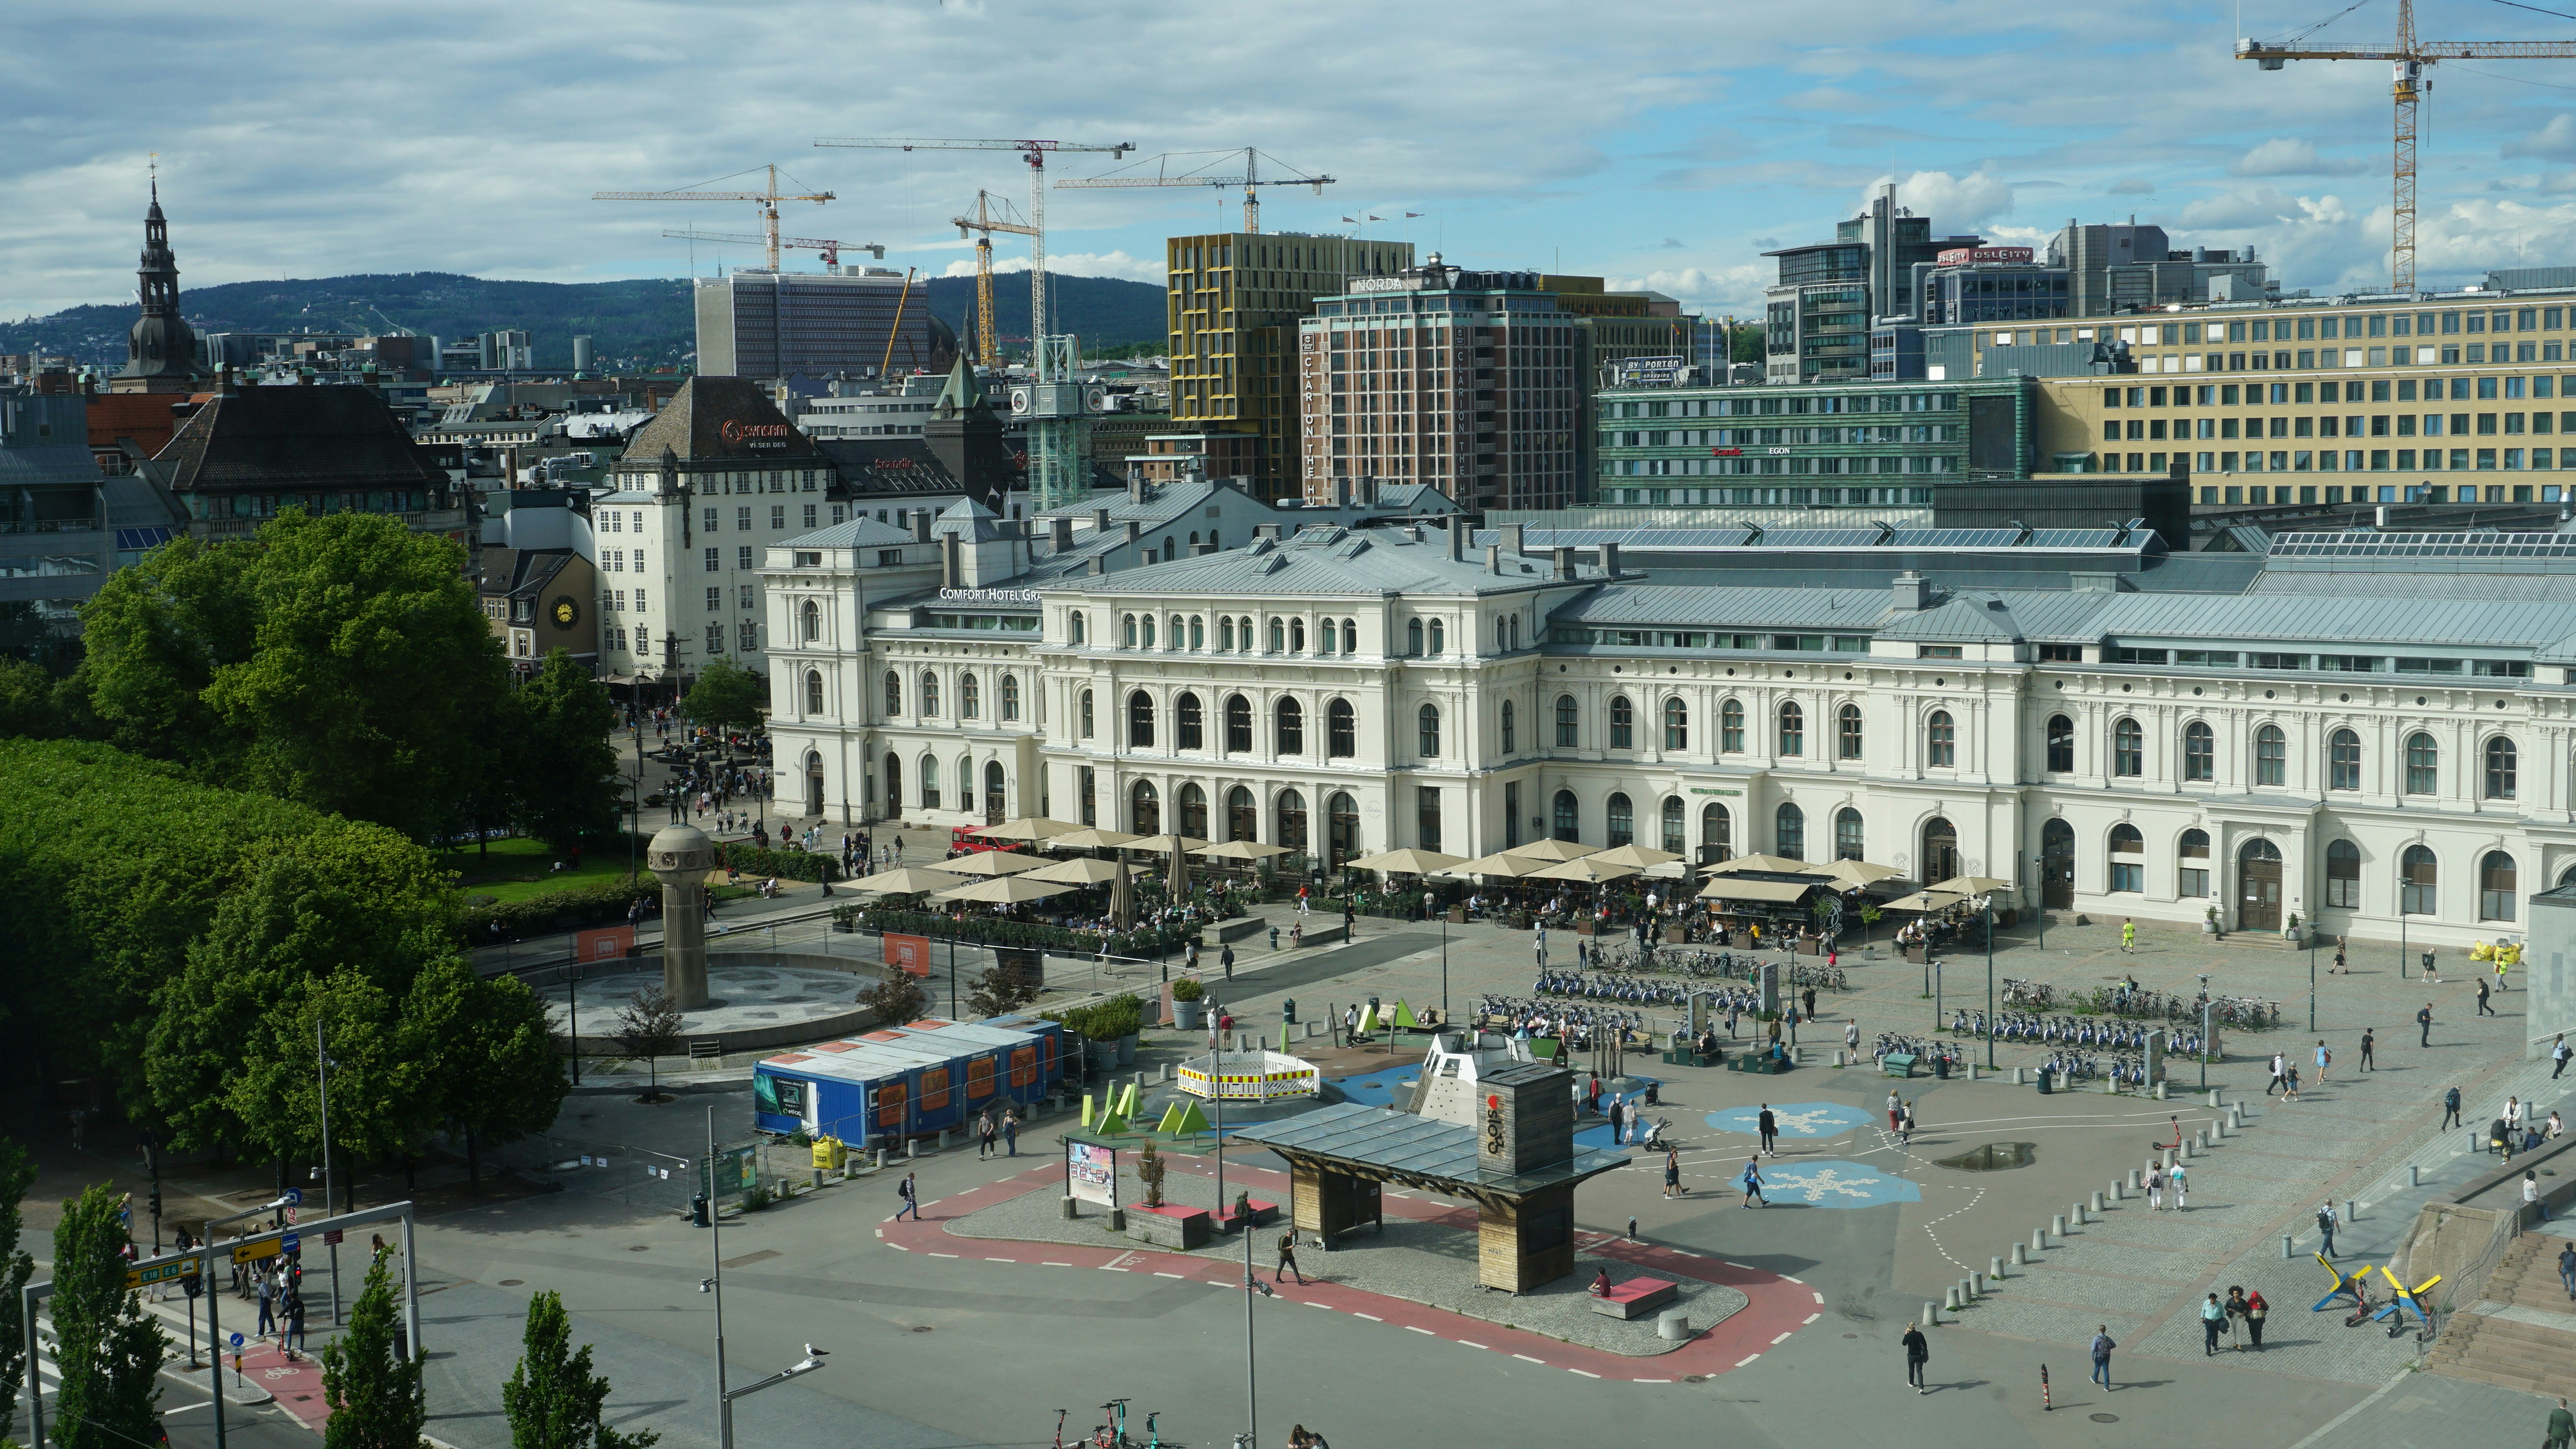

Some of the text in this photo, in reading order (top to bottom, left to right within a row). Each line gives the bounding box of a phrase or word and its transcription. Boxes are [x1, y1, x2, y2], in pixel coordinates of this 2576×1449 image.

[1357, 277, 1403, 292] NORDA
[1305, 357, 1314, 436] CLARION
[1711, 447, 1743, 456] Scandic
[875, 457, 914, 470] Scandic
[940, 587, 986, 600] COMFORT
[989, 588, 1020, 600] HOTEL
